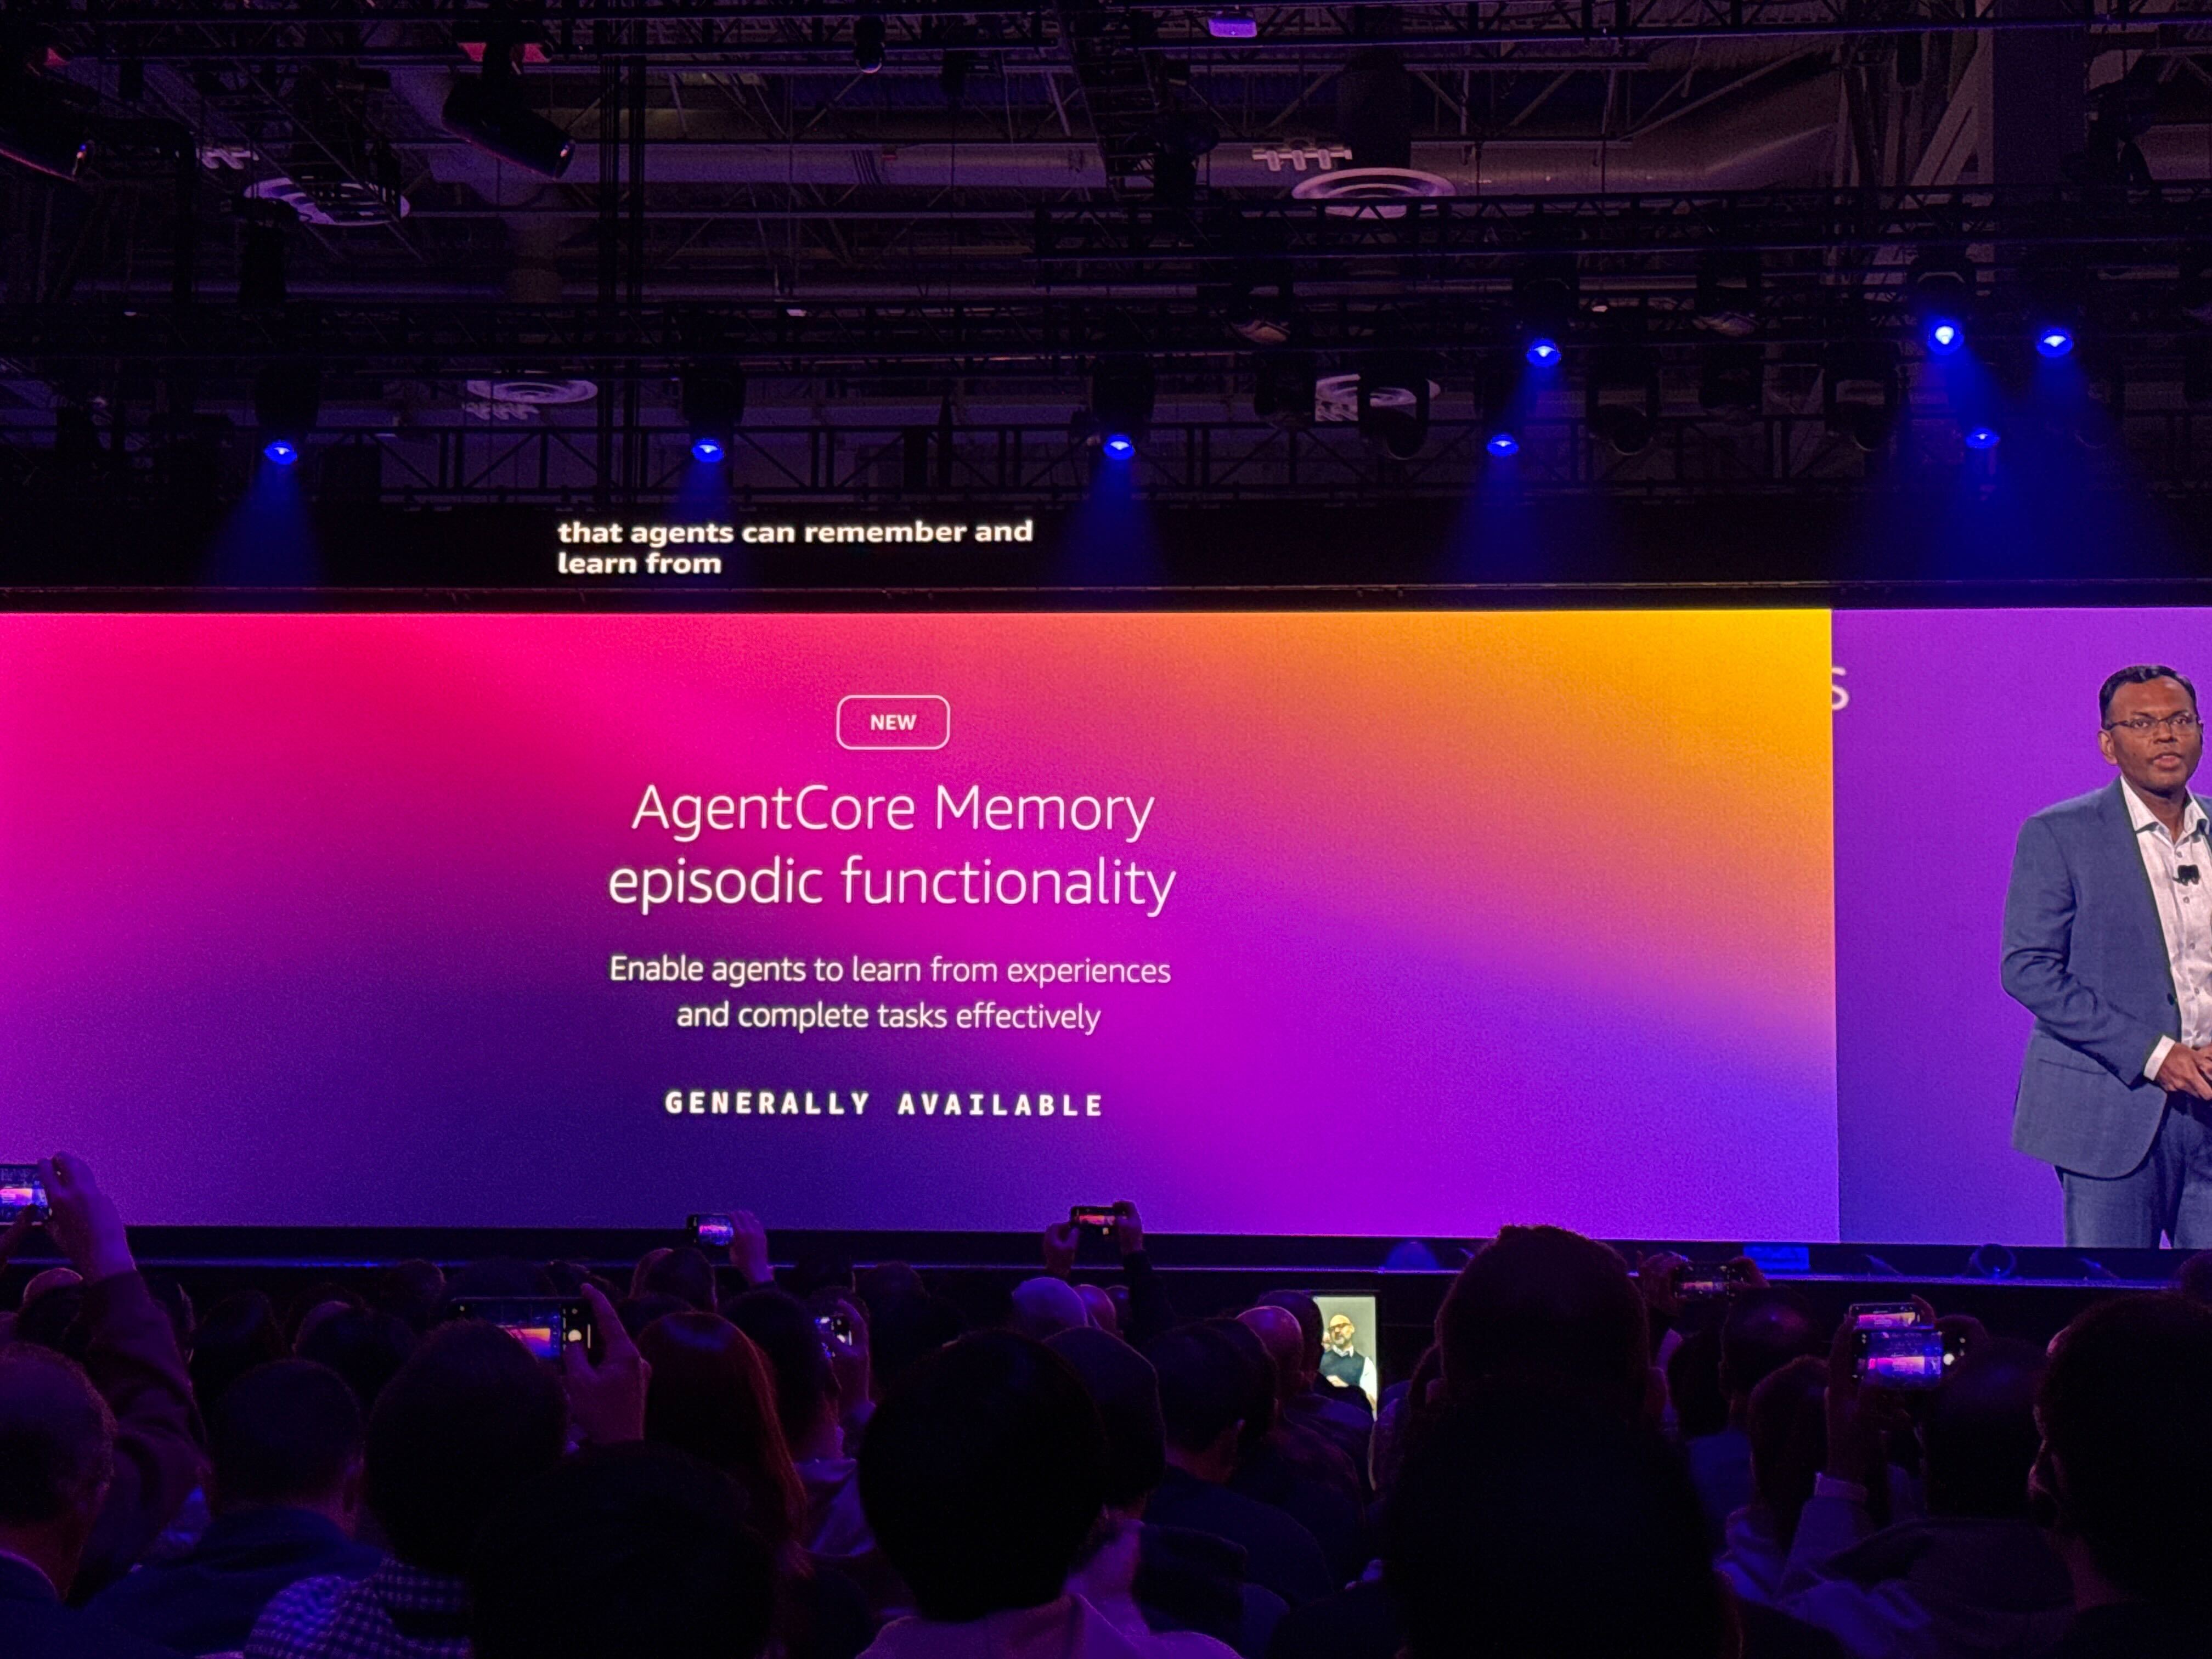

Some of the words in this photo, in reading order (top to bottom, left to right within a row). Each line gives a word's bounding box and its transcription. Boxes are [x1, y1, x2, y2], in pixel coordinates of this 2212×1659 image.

[558, 521, 623, 543] that
[631, 523, 733, 548] agents
[742, 527, 794, 542] can
[805, 521, 967, 542] remember
[975, 520, 1032, 541] and
[558, 552, 636, 573] learn
[646, 552, 721, 573] from
[871, 714, 917, 730] NEW
[632, 785, 915, 842] AgentCore
[938, 785, 1155, 843] Memory
[609, 855, 823, 915] episodic
[840, 855, 1177, 917] functionality
[611, 954, 703, 981] Enable
[712, 957, 806, 988] agents
[814, 958, 843, 981] to
[853, 956, 921, 981] learn
[930, 956, 997, 981] from
[1007, 958, 1171, 989] experiences
[678, 1000, 729, 1026] and
[738, 1001, 868, 1034] complete
[877, 1002, 947, 1028] tasks
[957, 1002, 1101, 1036] effectively
[665, 1091, 869, 1115] GENERALLY
[898, 1093, 1102, 1116] AVAILABLE
